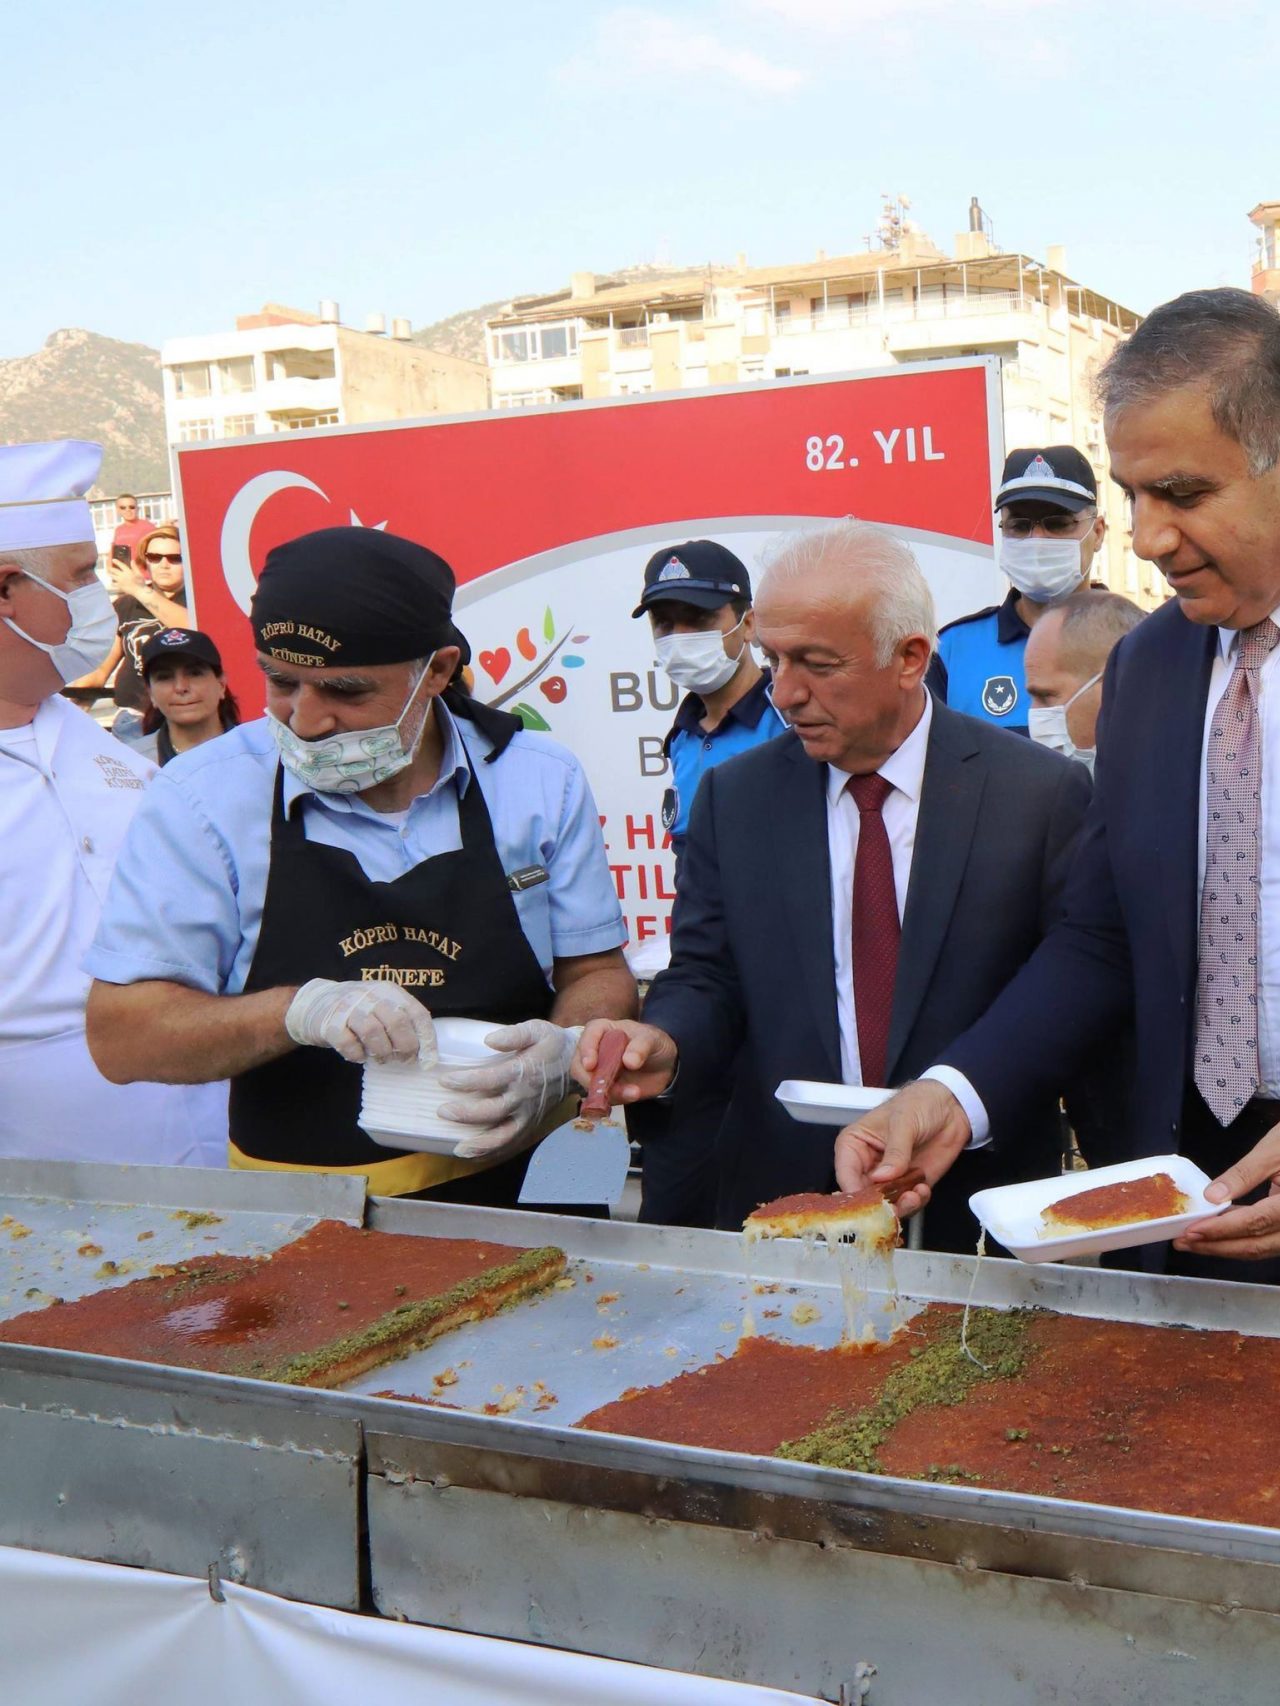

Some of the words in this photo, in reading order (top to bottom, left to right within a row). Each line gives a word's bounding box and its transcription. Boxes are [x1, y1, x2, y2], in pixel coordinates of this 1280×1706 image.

[806, 434, 859, 471] 82.
[873, 426, 945, 464] YIL
[260, 621, 295, 640] KÖPRÜ
[297, 623, 342, 652] HATAY
[269, 647, 326, 667] KÜNEFE
[338, 922, 398, 957] KÖPRÜ
[403, 926, 462, 961] HATAY
[360, 964, 446, 987] KÜNEFE
